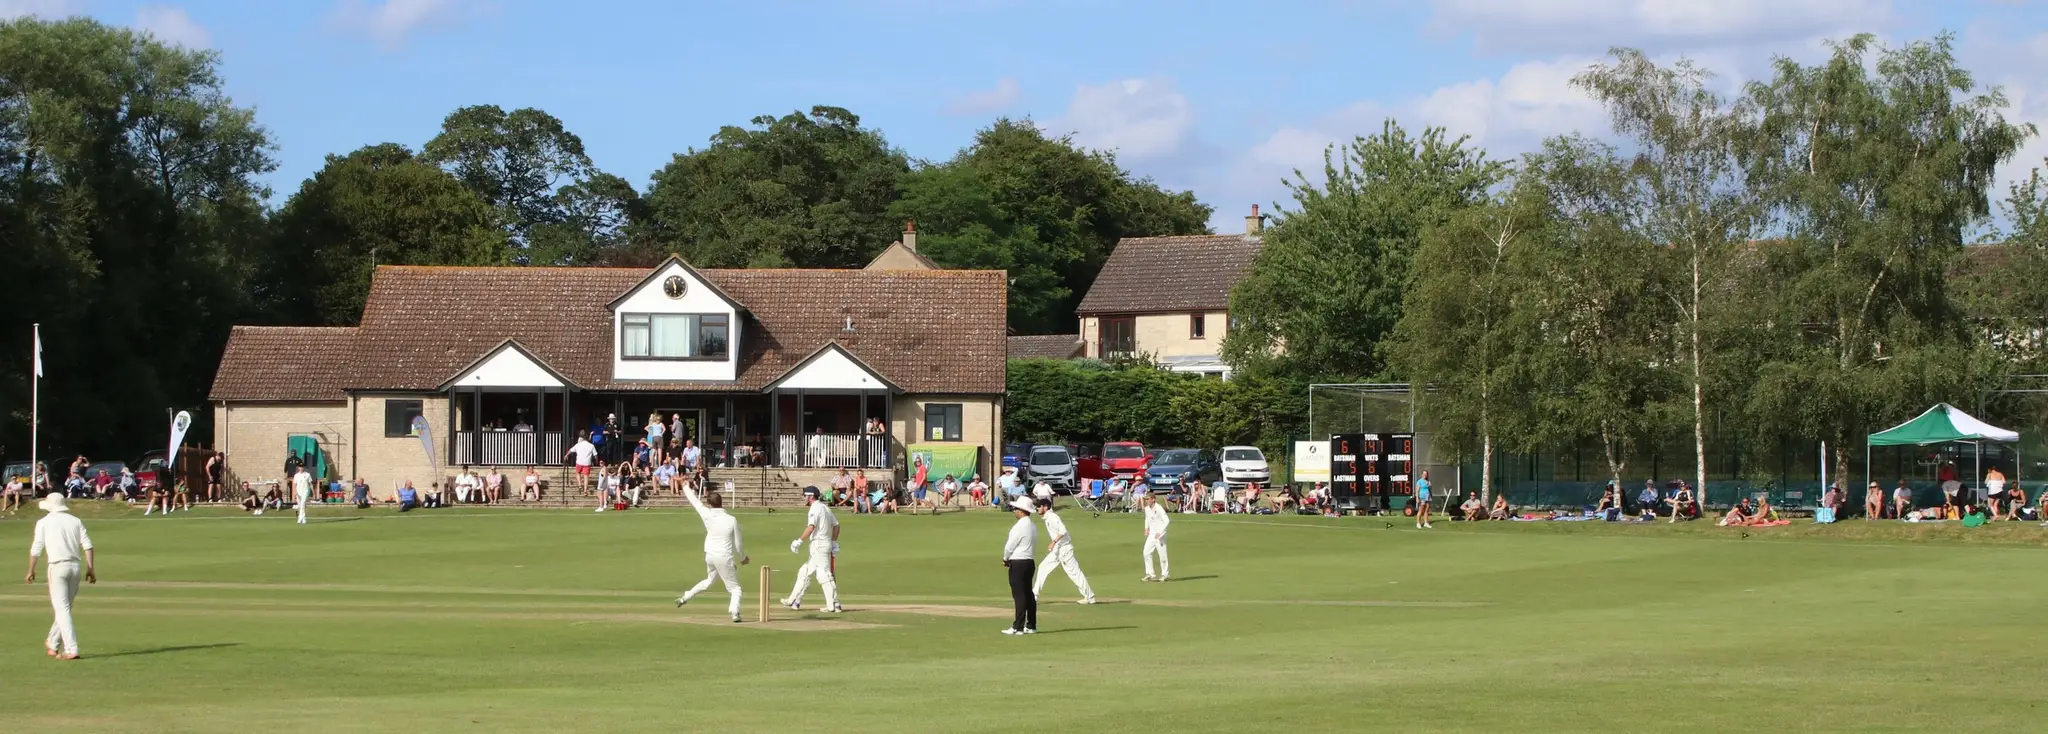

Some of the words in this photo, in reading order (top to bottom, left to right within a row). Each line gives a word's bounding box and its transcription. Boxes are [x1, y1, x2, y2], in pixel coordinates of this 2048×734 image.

[1364, 433, 1379, 441] TOTAL
[1341, 440, 1348, 454] 6
[1364, 440, 1384, 453] 141
[1404, 440, 1411, 453] 8
[1349, 461, 1356, 474] 5
[1368, 461, 1375, 474] 6
[1404, 461, 1411, 474] 0
[1349, 482, 1356, 493] 4
[1365, 481, 1380, 494] 31
[1391, 481, 1411, 494] 176
